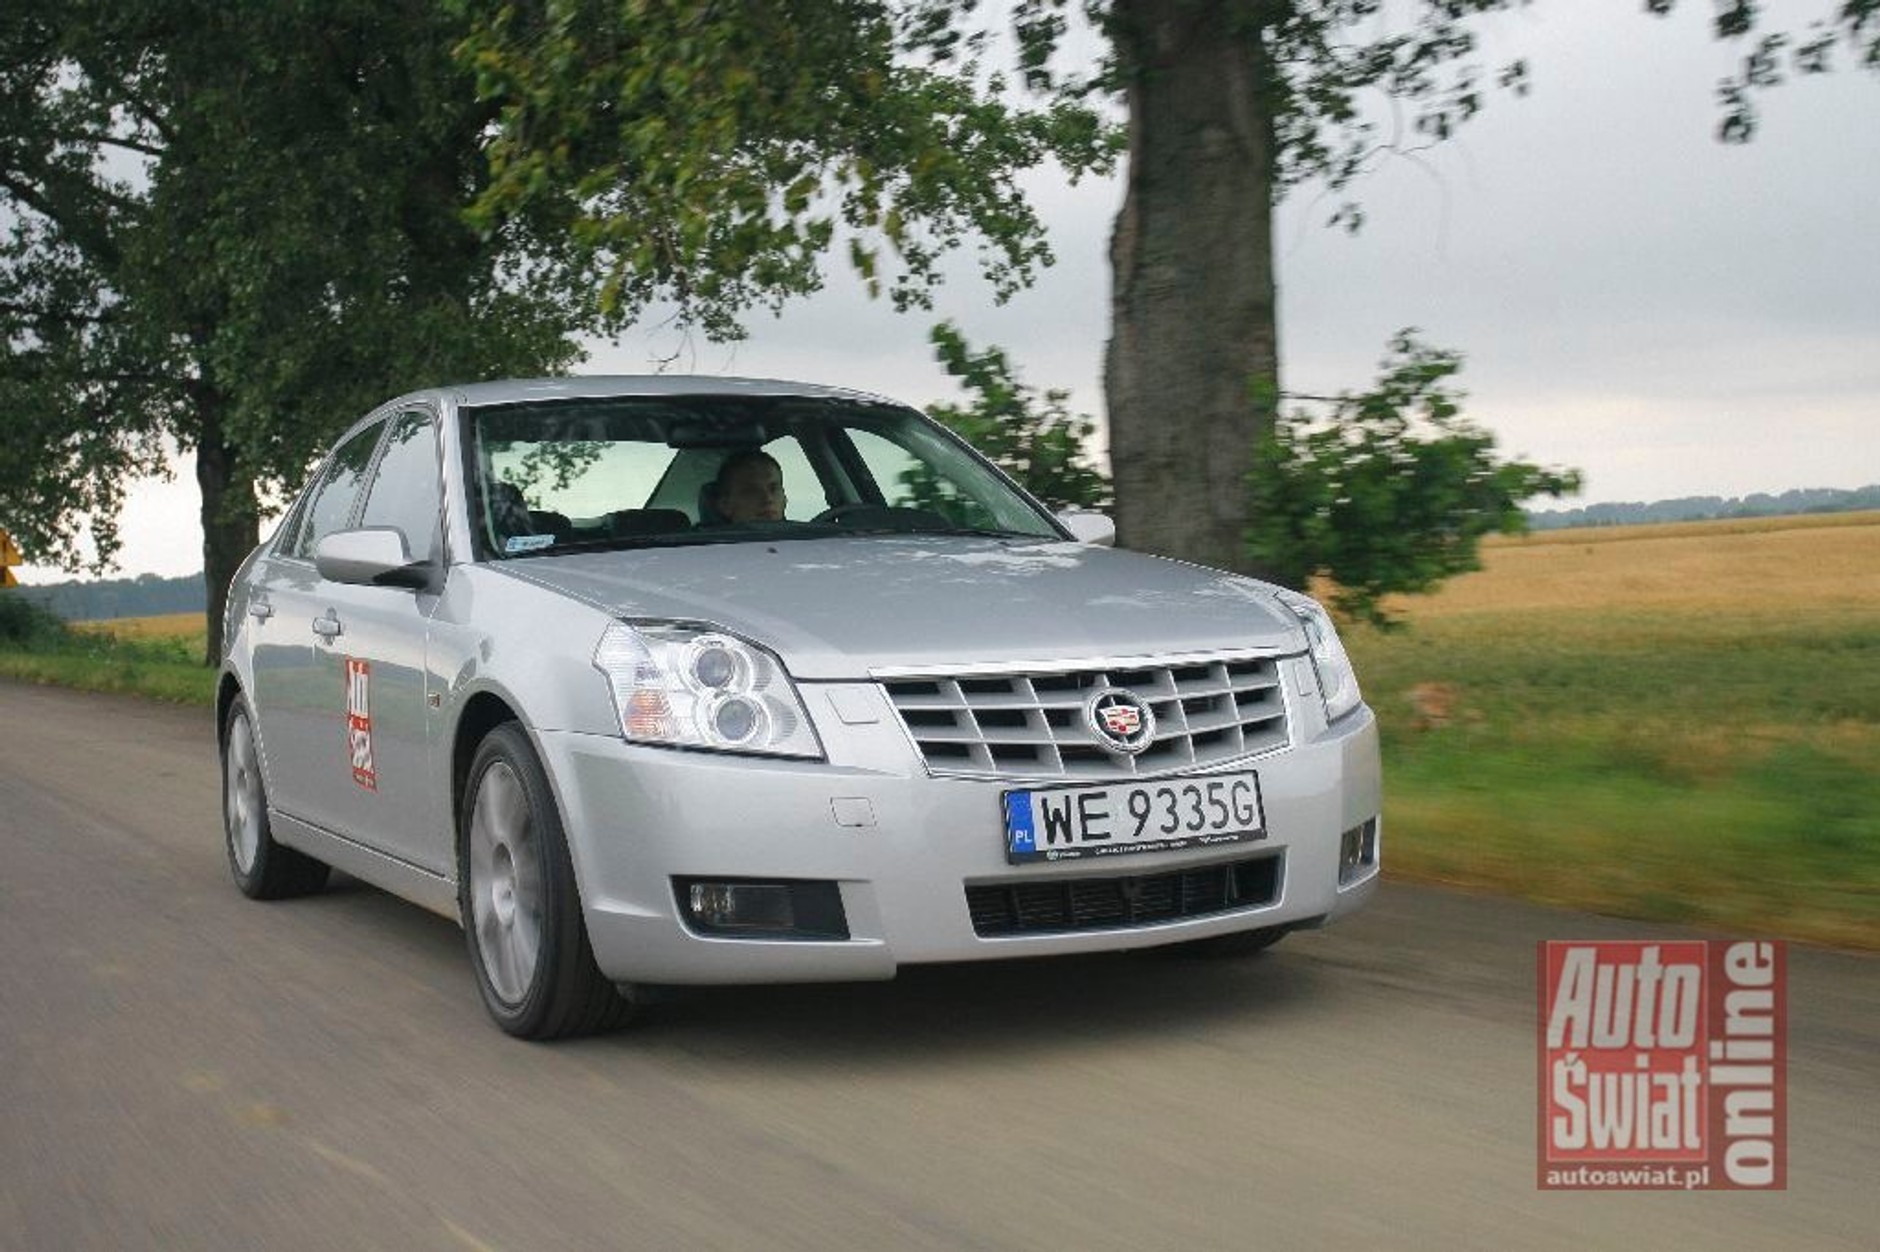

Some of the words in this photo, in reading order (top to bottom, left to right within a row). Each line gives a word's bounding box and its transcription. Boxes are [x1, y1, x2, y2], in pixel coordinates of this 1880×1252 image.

[1041, 791, 1111, 844] WE
[1127, 780, 1254, 837] 9335G
[1015, 829, 1033, 843] PL
